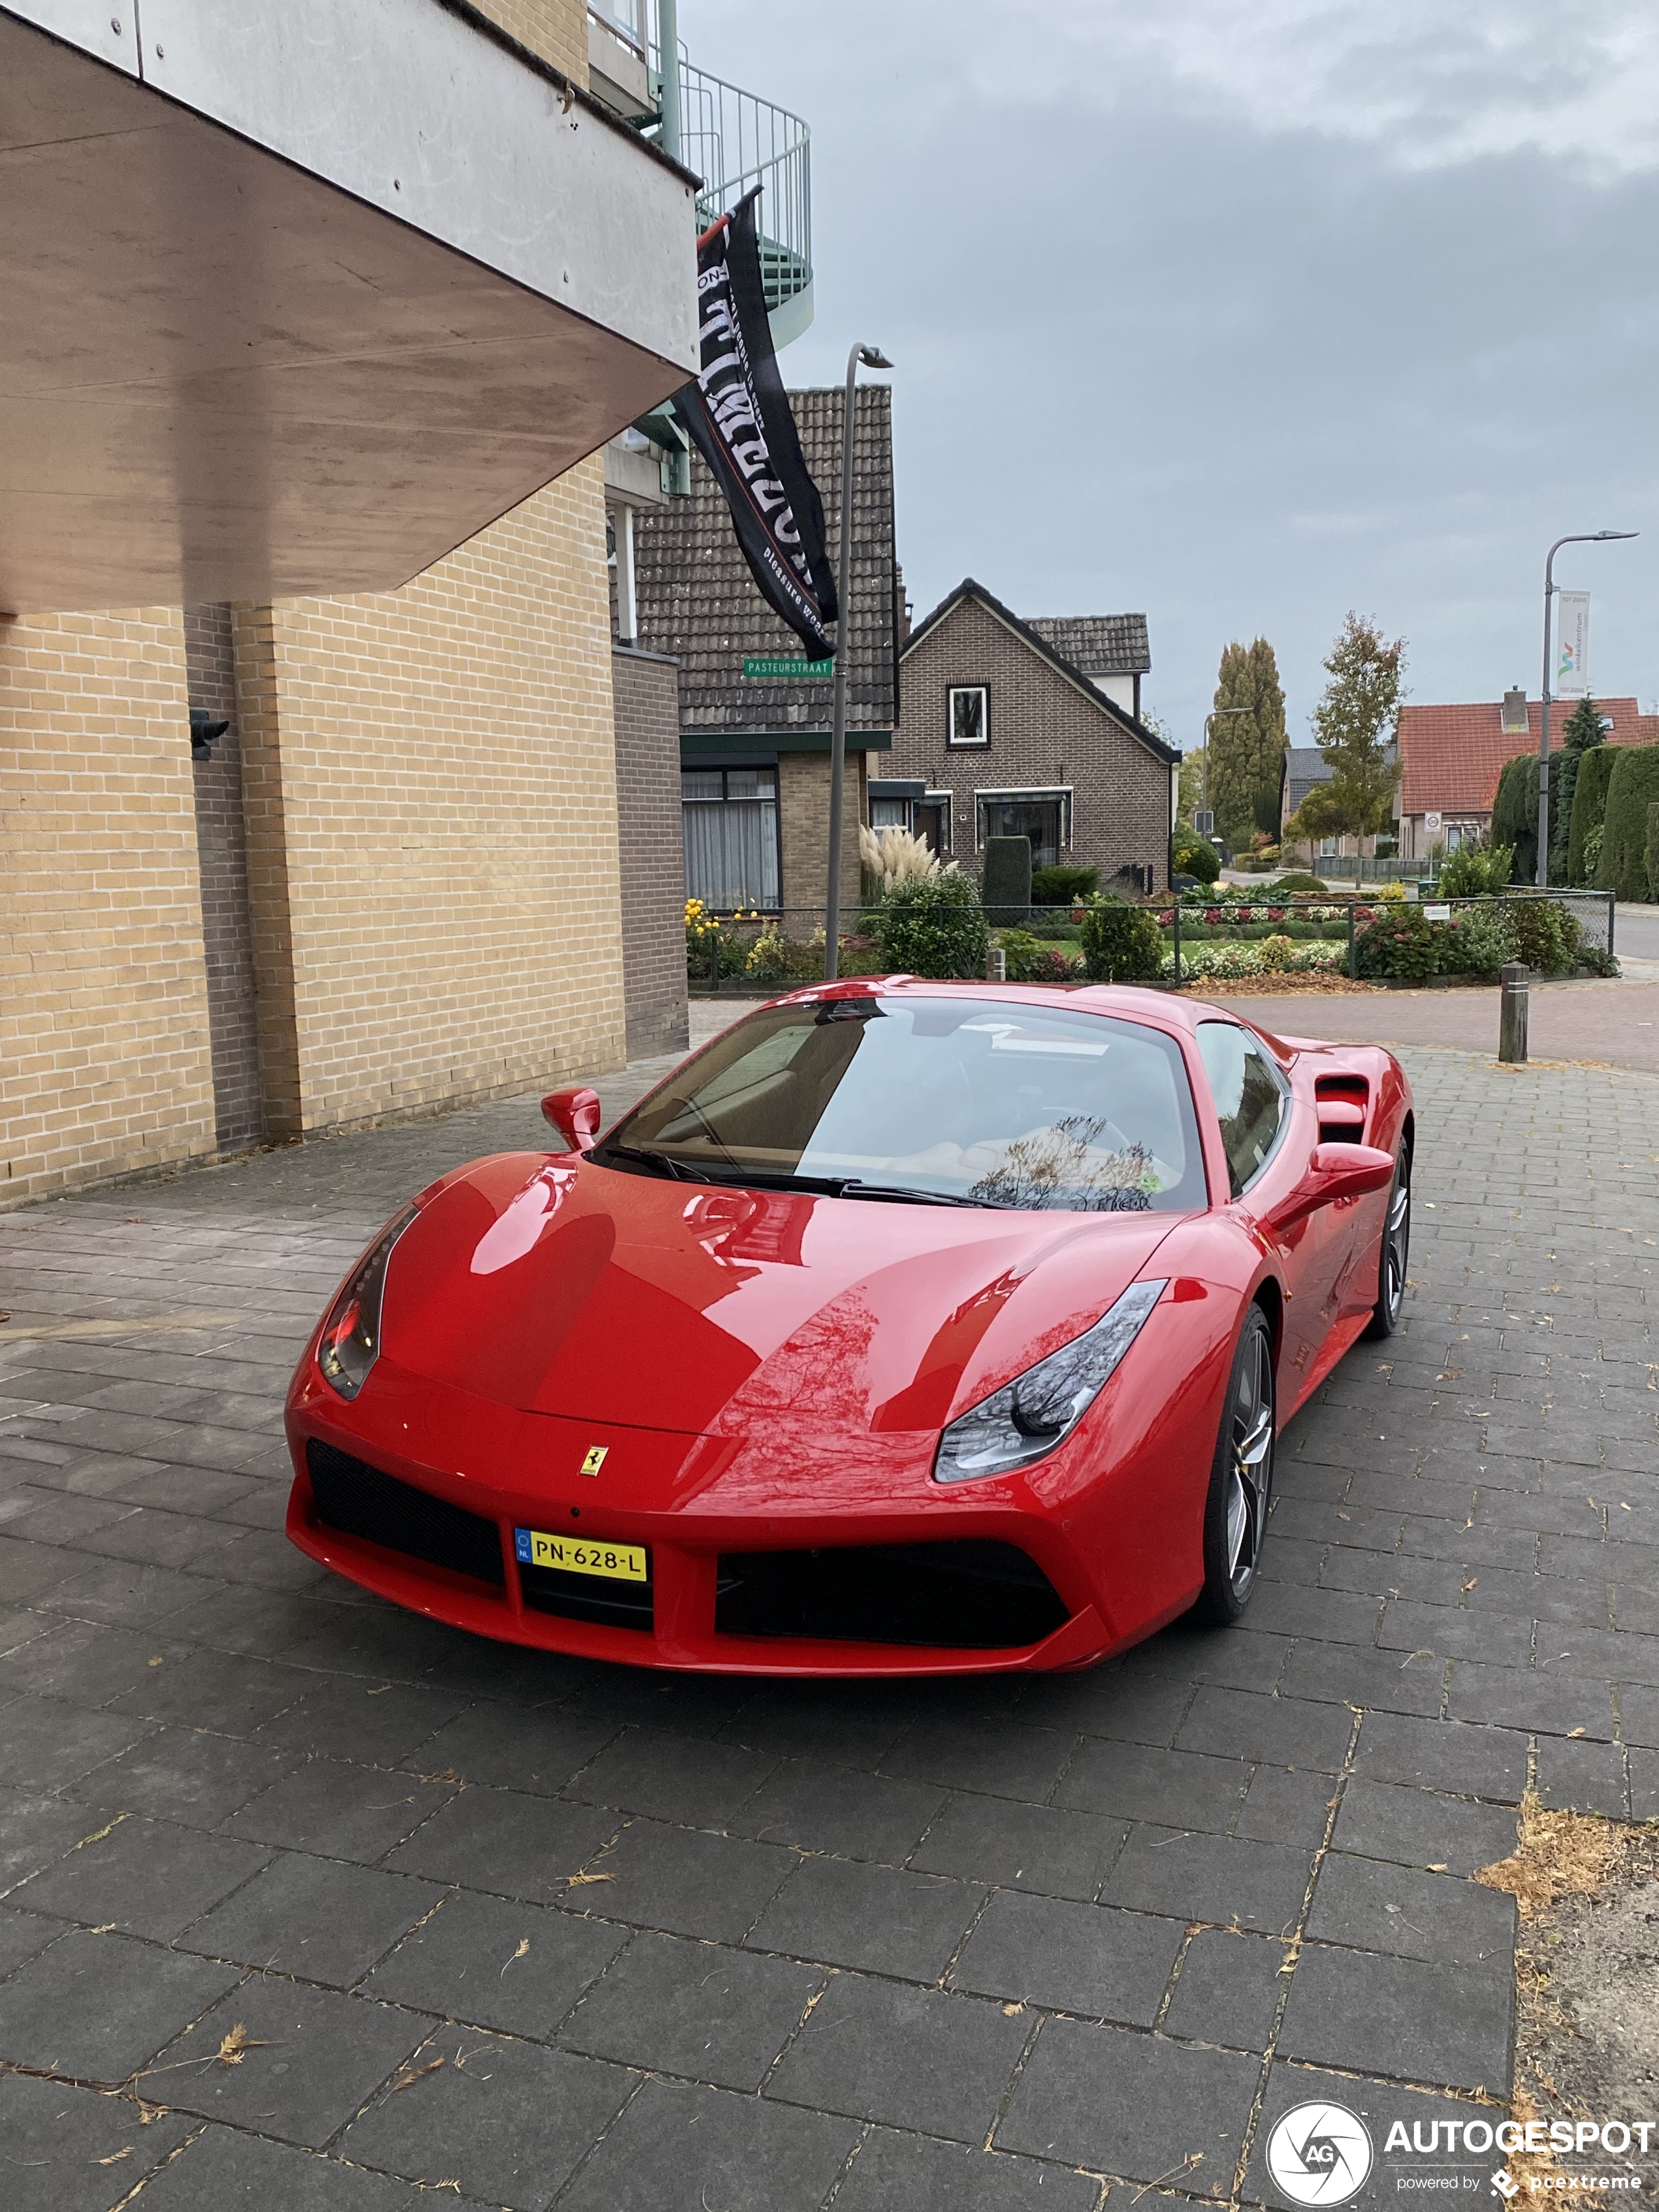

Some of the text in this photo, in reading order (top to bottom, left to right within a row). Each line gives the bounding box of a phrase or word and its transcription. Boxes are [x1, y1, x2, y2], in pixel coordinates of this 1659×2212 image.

[763, 547, 801, 605] pleasure
[1574, 613, 1583, 672] winkelcentrum
[748, 662, 828, 673] PASTEURSTRAAT
[519, 1550, 529, 1558] NL
[536, 1540, 641, 1572] PN-628-L
